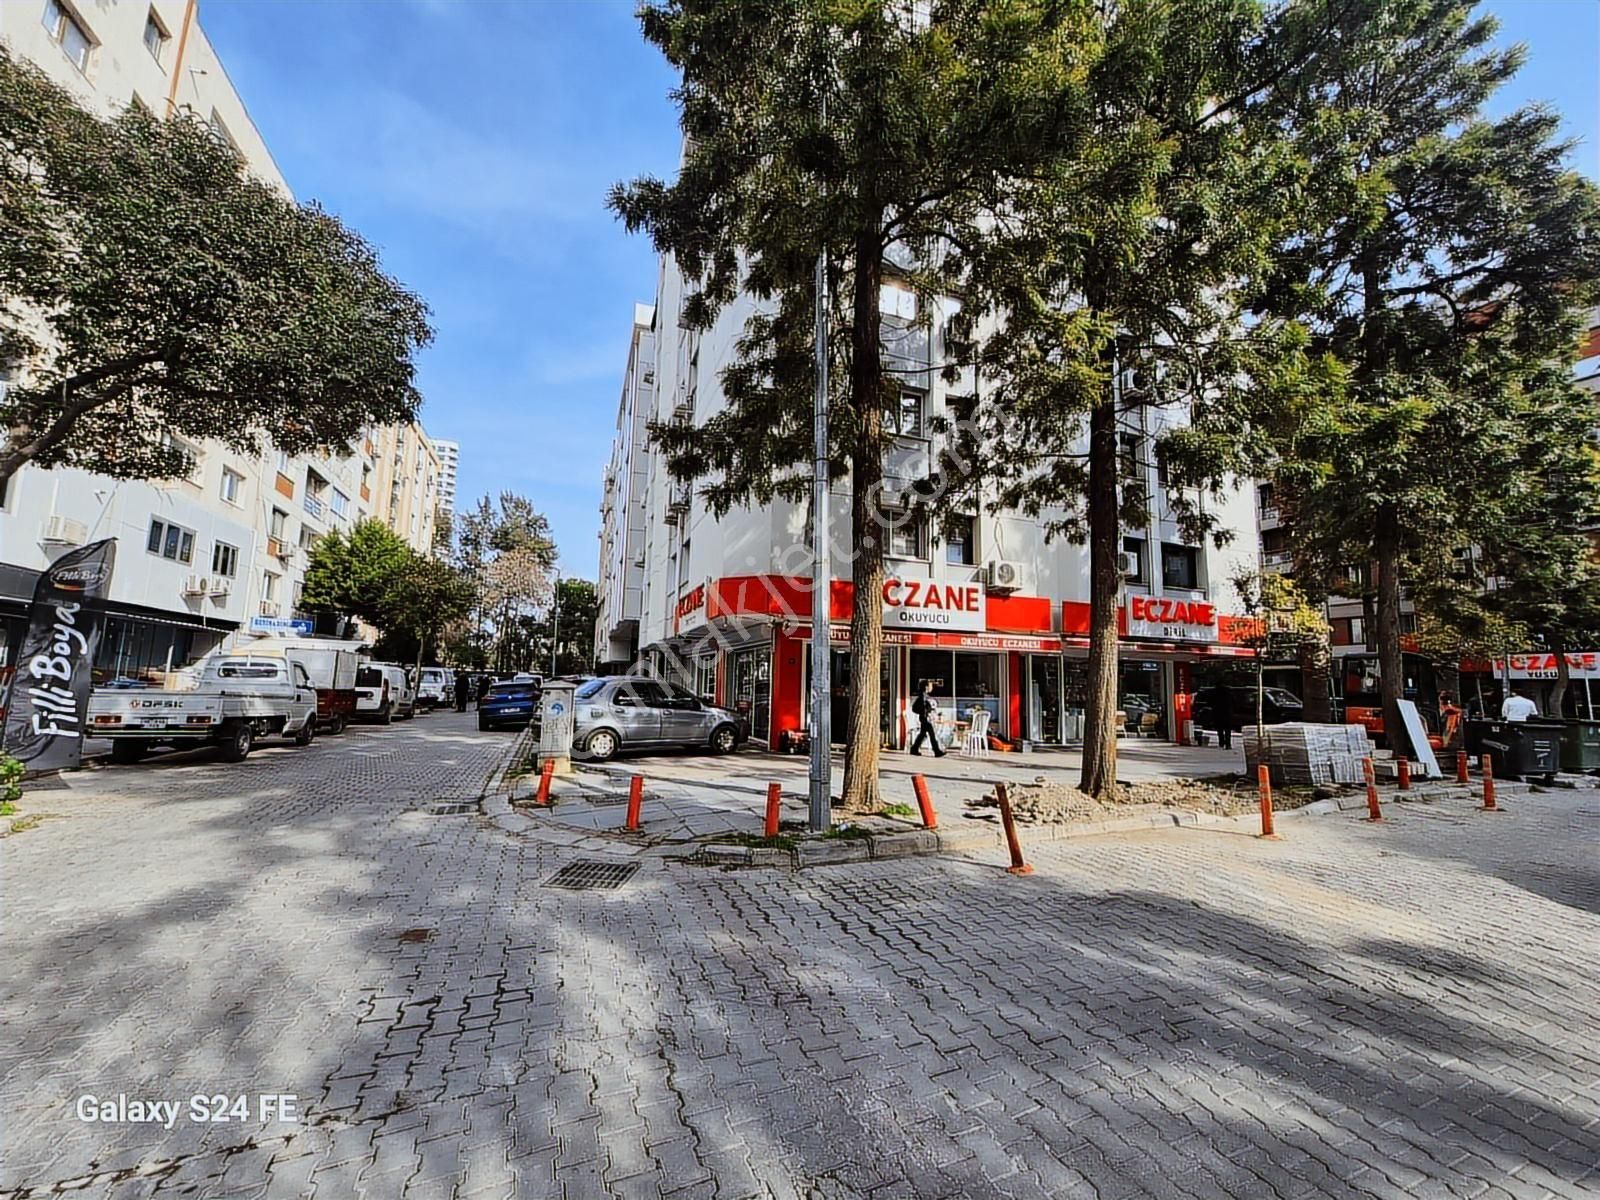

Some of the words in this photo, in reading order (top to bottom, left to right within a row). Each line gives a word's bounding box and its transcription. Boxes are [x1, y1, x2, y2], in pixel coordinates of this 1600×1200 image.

[882, 579, 979, 612] CZANE
[900, 611, 949, 623] OKUYUCU
[1132, 597, 1215, 626] ECZANE
[29, 602, 88, 681] Boya
[960, 637, 999, 646] OKUYUCU
[29, 684, 80, 736] Filli
